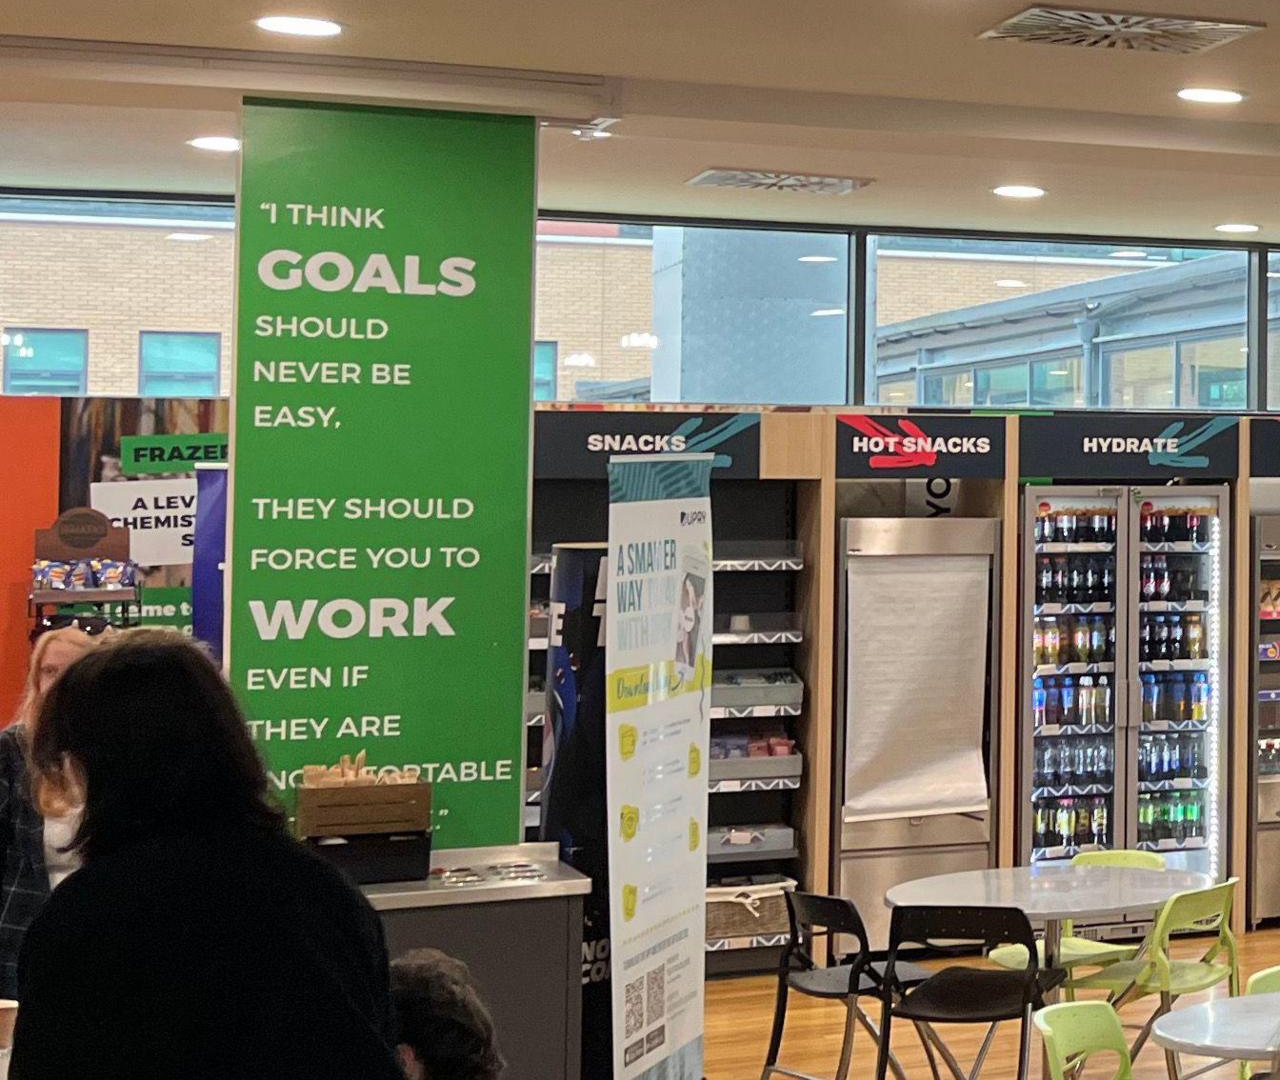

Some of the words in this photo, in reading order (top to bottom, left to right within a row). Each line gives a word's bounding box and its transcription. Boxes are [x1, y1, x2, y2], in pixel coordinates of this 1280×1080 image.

[286, 203, 385, 229] THINK
[257, 248, 477, 297] GOALS
[254, 315, 389, 339] SHOULD
[253, 360, 361, 384] NEVER
[371, 363, 412, 385] BE
[253, 405, 342, 429] EASY,
[587, 434, 687, 452] SNACKS
[852, 436, 898, 453] HOT
[901, 436, 991, 454] SNACKS
[1083, 437, 1179, 454] HYDRATE
[131, 497, 148, 511] A
[251, 497, 337, 520] THEY
[343, 497, 475, 520] SHOULD
[111, 514, 196, 530] CHEMIS
[250, 548, 358, 571] FORCE
[366, 547, 432, 569] YOU
[439, 546, 481, 569] TO
[616, 544, 625, 576] A
[616, 578, 644, 614] WAY
[248, 596, 457, 641] WORK
[246, 666, 332, 690] EVEN
[342, 665, 369, 688] IF
[247, 717, 329, 742] THEY
[336, 714, 401, 739] ARE
